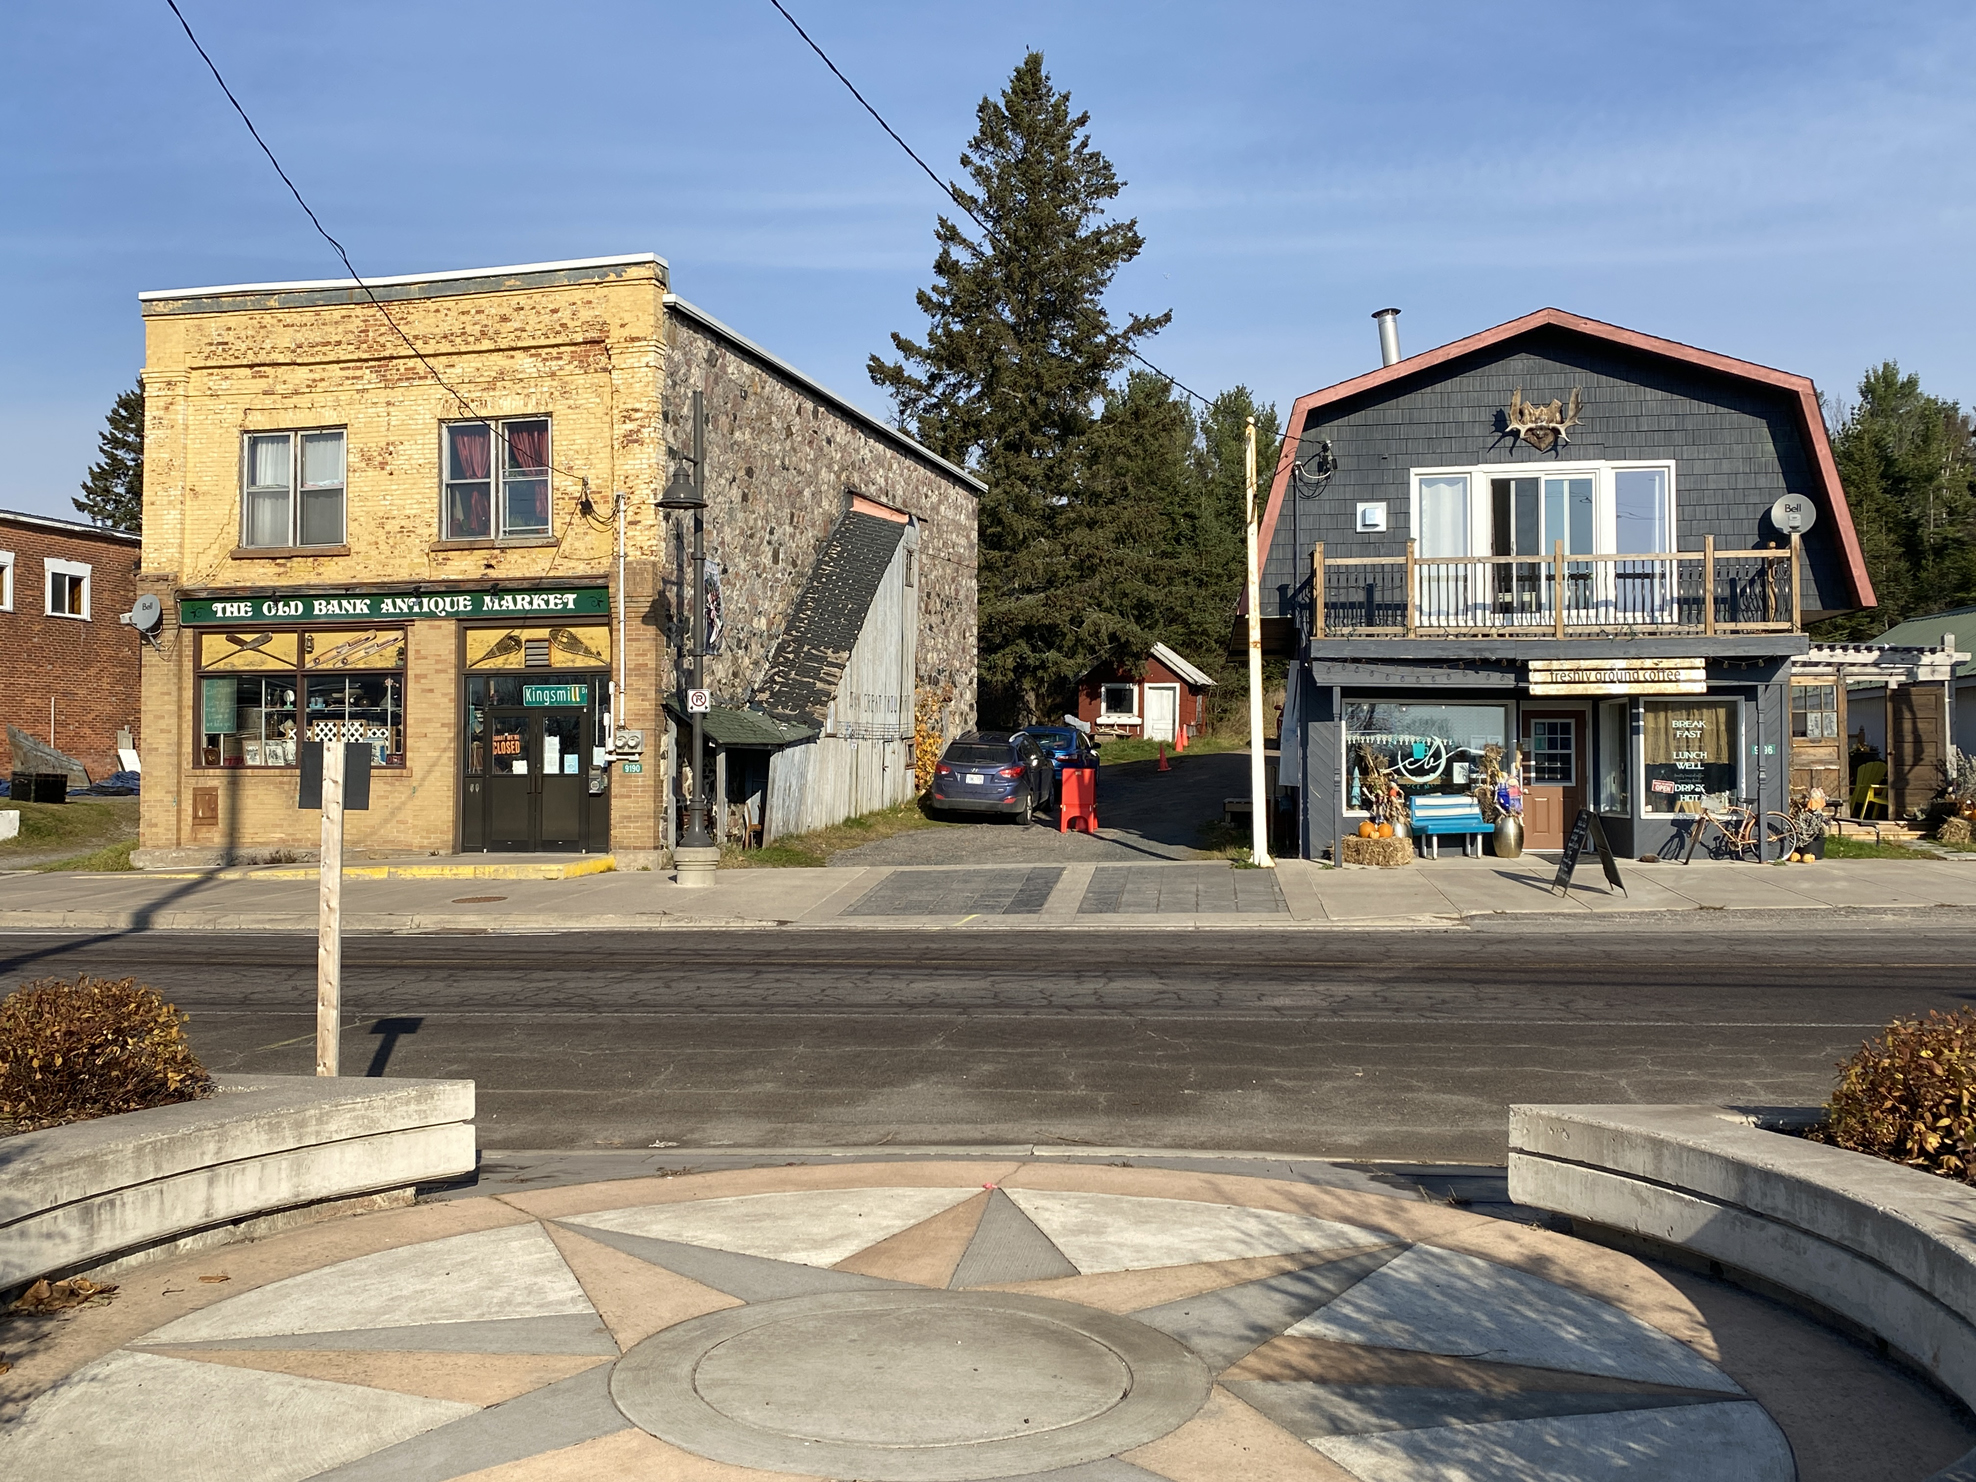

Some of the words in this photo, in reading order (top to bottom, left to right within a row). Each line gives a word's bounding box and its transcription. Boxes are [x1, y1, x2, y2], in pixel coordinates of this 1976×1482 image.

[1784, 503, 1802, 513] Bell
[141, 601, 154, 611] Bell
[211, 601, 253, 618] THE
[262, 599, 304, 616] OLD
[312, 598, 371, 615] BANK
[380, 595, 473, 617] ANTIQUE
[482, 593, 577, 611] MARKET
[1549, 668, 1592, 683] freshly
[1594, 668, 1640, 683] ground
[1643, 668, 1681, 682] coffee
[525, 686, 580, 706] Kingsmill
[1672, 720, 1707, 728] BREAK
[1676, 730, 1702, 738] FAST
[493, 740, 520, 755] CLOSED
[1673, 751, 1708, 759] LUNCH
[624, 764, 641, 773] 9190
[1676, 761, 1705, 769] WELL
[1680, 794, 1701, 802] HOT
